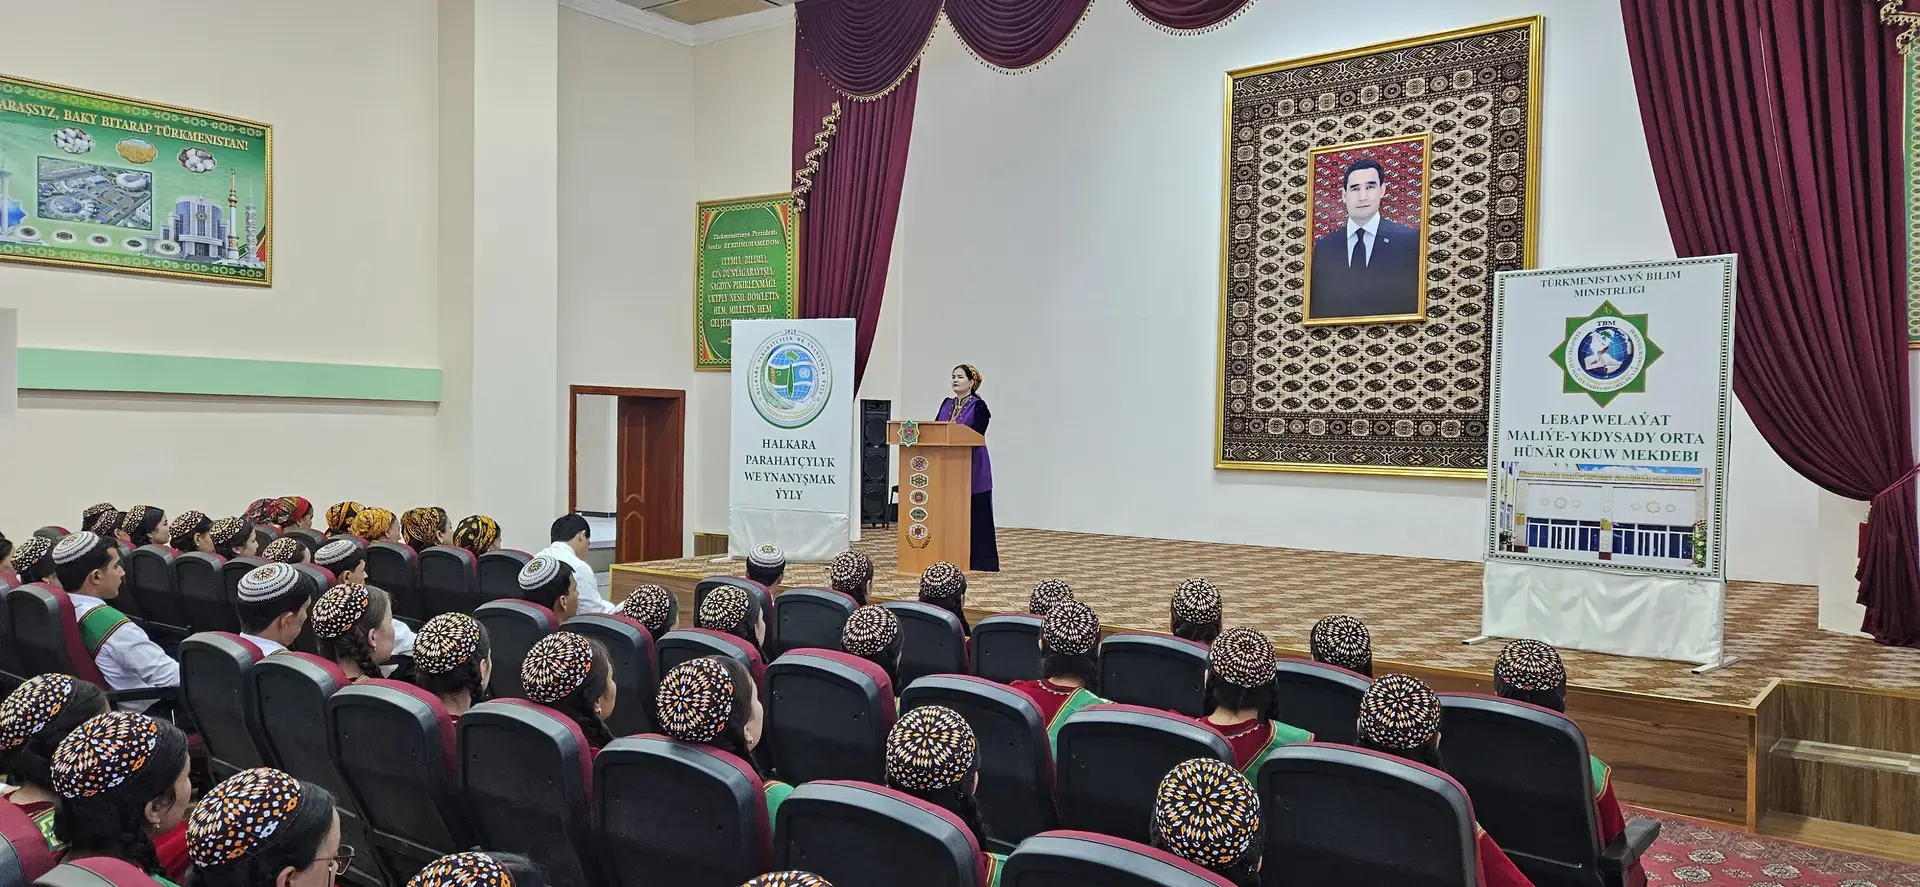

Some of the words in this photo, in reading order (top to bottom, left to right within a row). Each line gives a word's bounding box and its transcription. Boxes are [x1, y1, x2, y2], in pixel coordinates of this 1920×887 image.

[63, 109, 98, 125] BAKY
[101, 116, 153, 133] BITARAP
[154, 124, 249, 151] TÜRKMENISTAN!
[1540, 273, 1644, 289] TÜRKMENISTANYŇ
[1646, 270, 1681, 281] BILIM
[1574, 285, 1646, 298] MINISTRLIGI
[757, 304, 772, 313] HEM
[1540, 413, 1589, 426] LEBAP
[1592, 411, 1672, 427] WELAÝAT
[762, 438, 816, 450] HALKARA
[1507, 429, 1657, 444] MALIÝE-YKDYSADY
[1660, 432, 1705, 445] ORTA
[1513, 445, 1566, 459] HÜNÄR
[1569, 447, 1618, 460] OKUW
[1621, 449, 1699, 463] MEKDEBI
[745, 455, 836, 470] PARAHATÇYLYK
[744, 472, 762, 482] WE
[764, 472, 836, 486] YNANYŞMAK
[775, 488, 803, 500] ÝYLY
